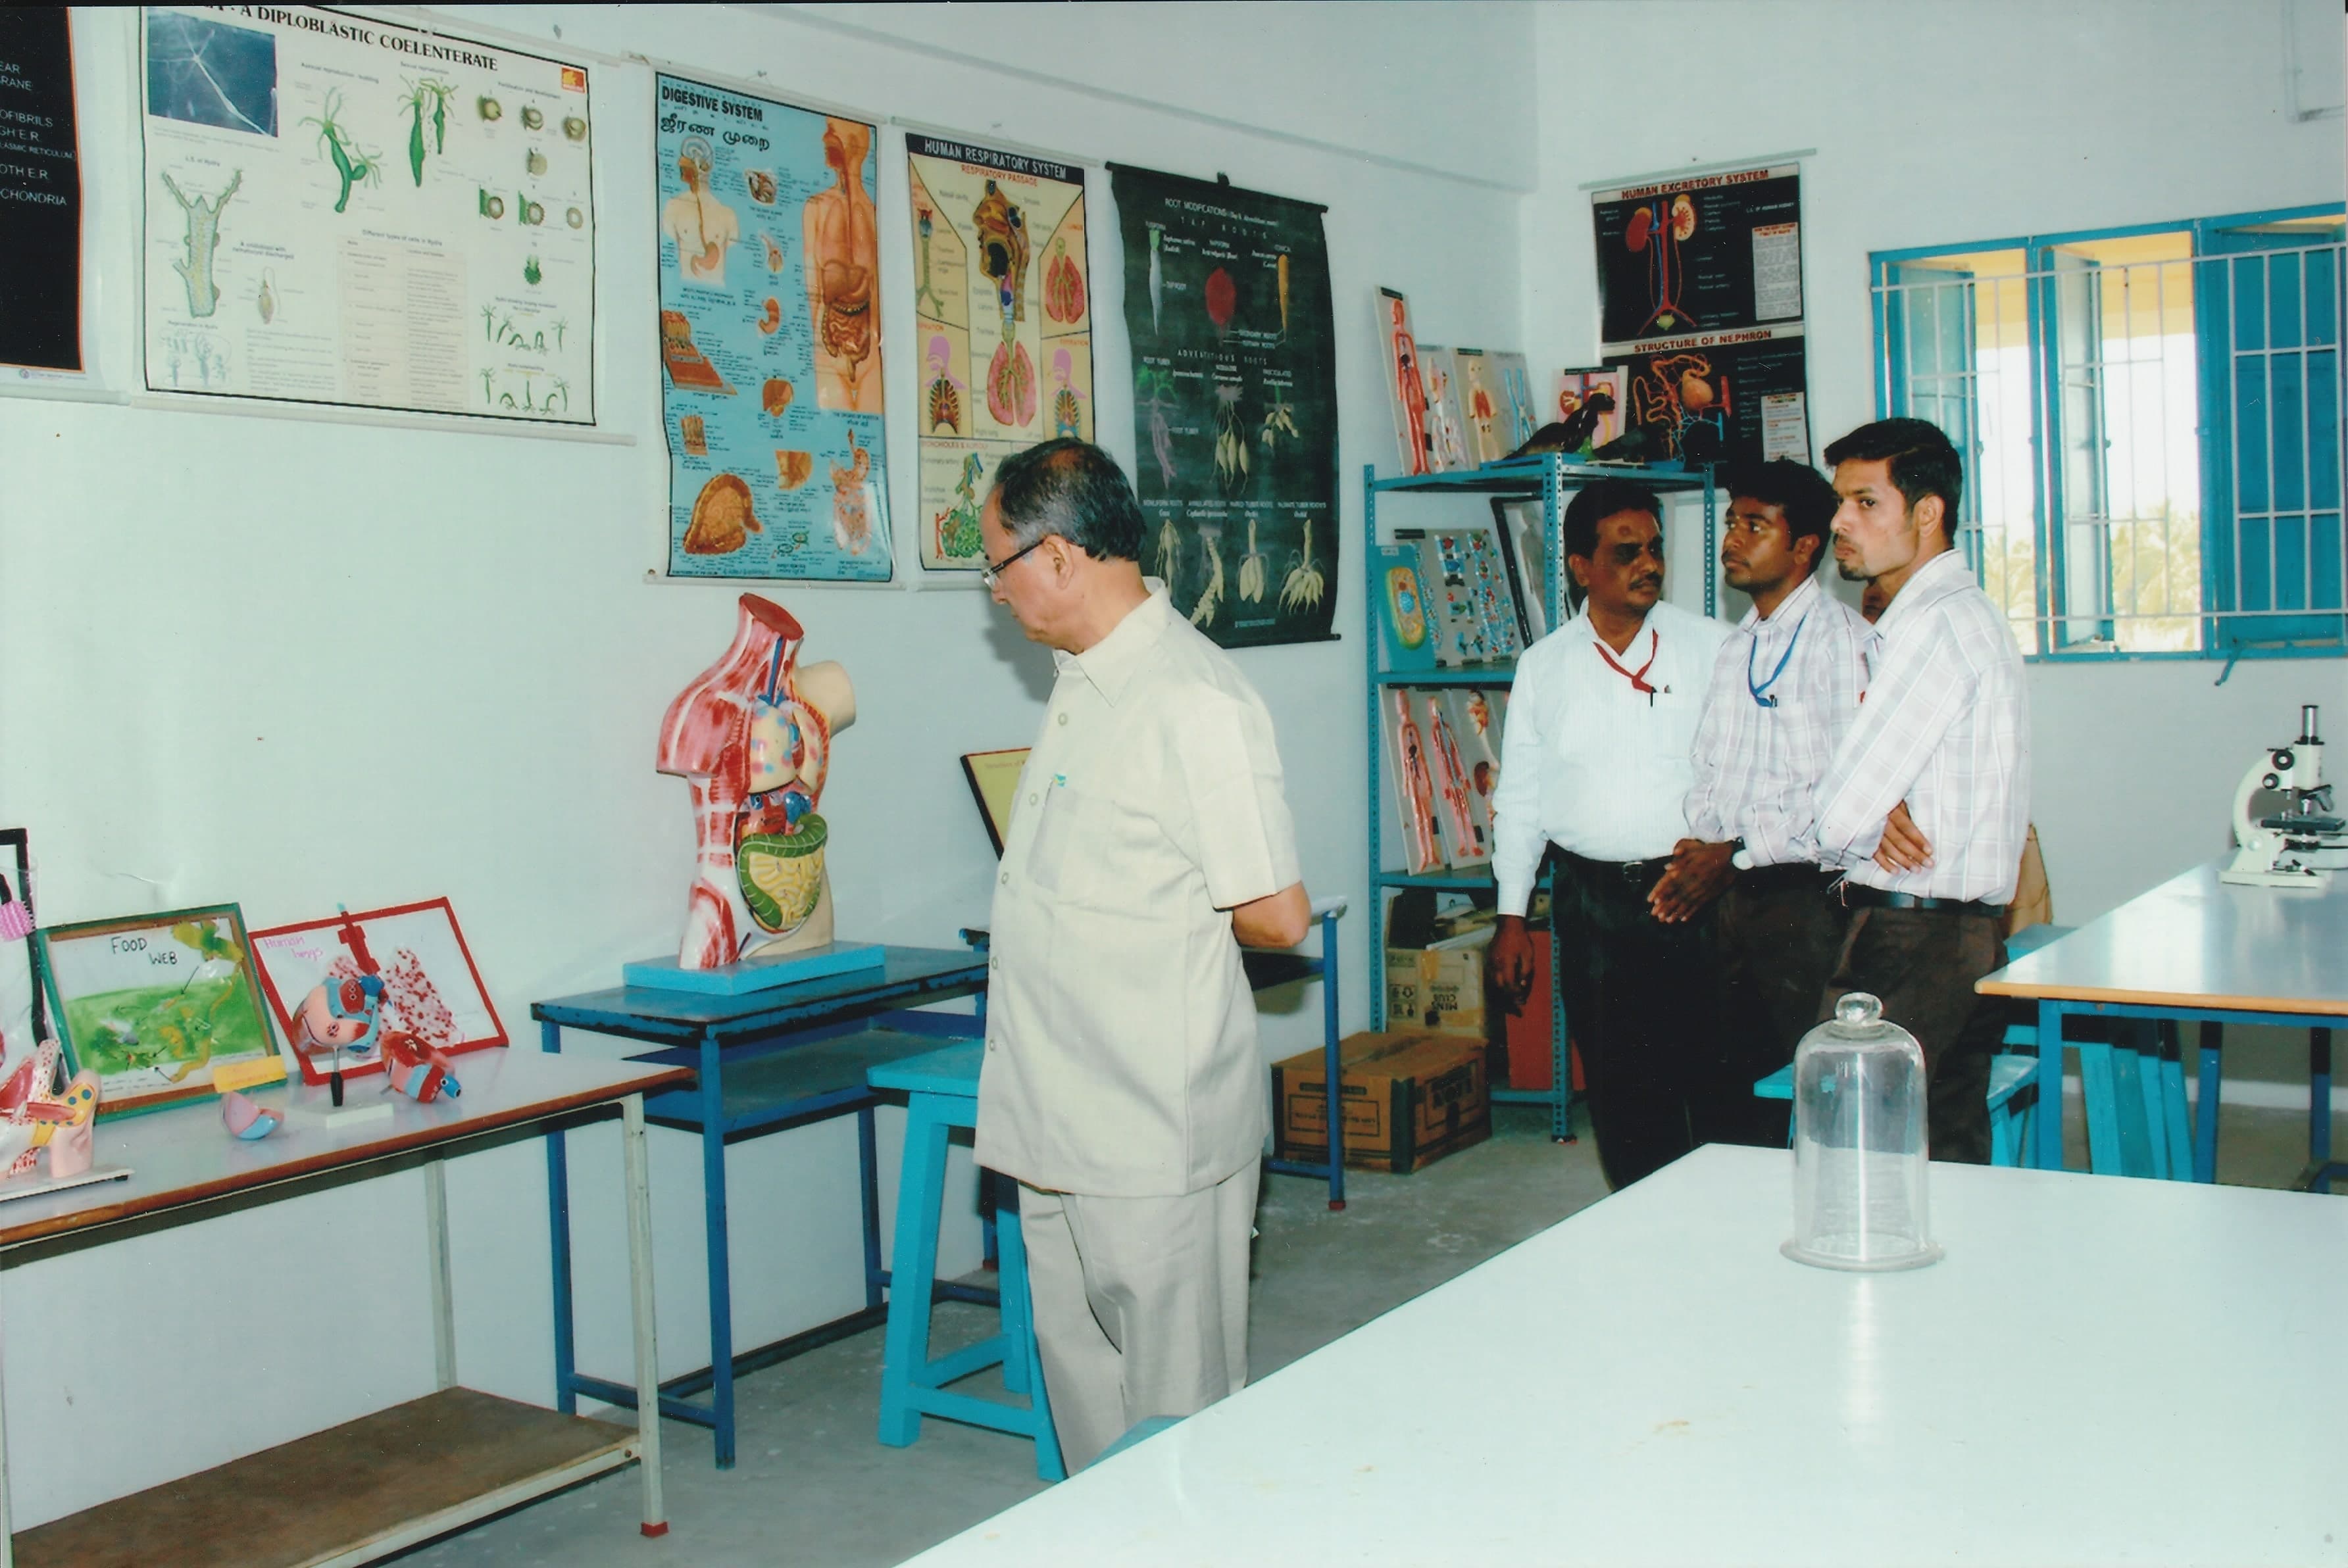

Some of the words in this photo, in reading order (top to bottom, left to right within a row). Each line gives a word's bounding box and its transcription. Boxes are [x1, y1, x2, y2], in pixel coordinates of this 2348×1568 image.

[257, 6, 375, 45] DIPLOBLASTIC
[380, 34, 498, 72] COELENTERATE
[662, 86, 718, 112] DIGESTIVE
[722, 101, 763, 122] SYSTEM
[924, 139, 962, 159] HUMAN
[965, 147, 1030, 172] RESPIRATORY
[1032, 160, 1066, 180] SYSTEM
[961, 164, 1006, 180] RESPIRATORY
[1007, 173, 1037, 187] PASSAGE
[1622, 186, 1658, 199] HUMAN
[1661, 176, 1722, 193] EXCRETORY
[1726, 170, 1769, 184] SYSTEM
[0, 188, 67, 206] CHONDRIA
[1634, 338, 1697, 353] STRUCTURE
[1701, 336, 1714, 345] OF
[1719, 330, 1772, 343] NEPHRON
[111, 937, 147, 954] FOOD
[149, 950, 178, 966] WEB
